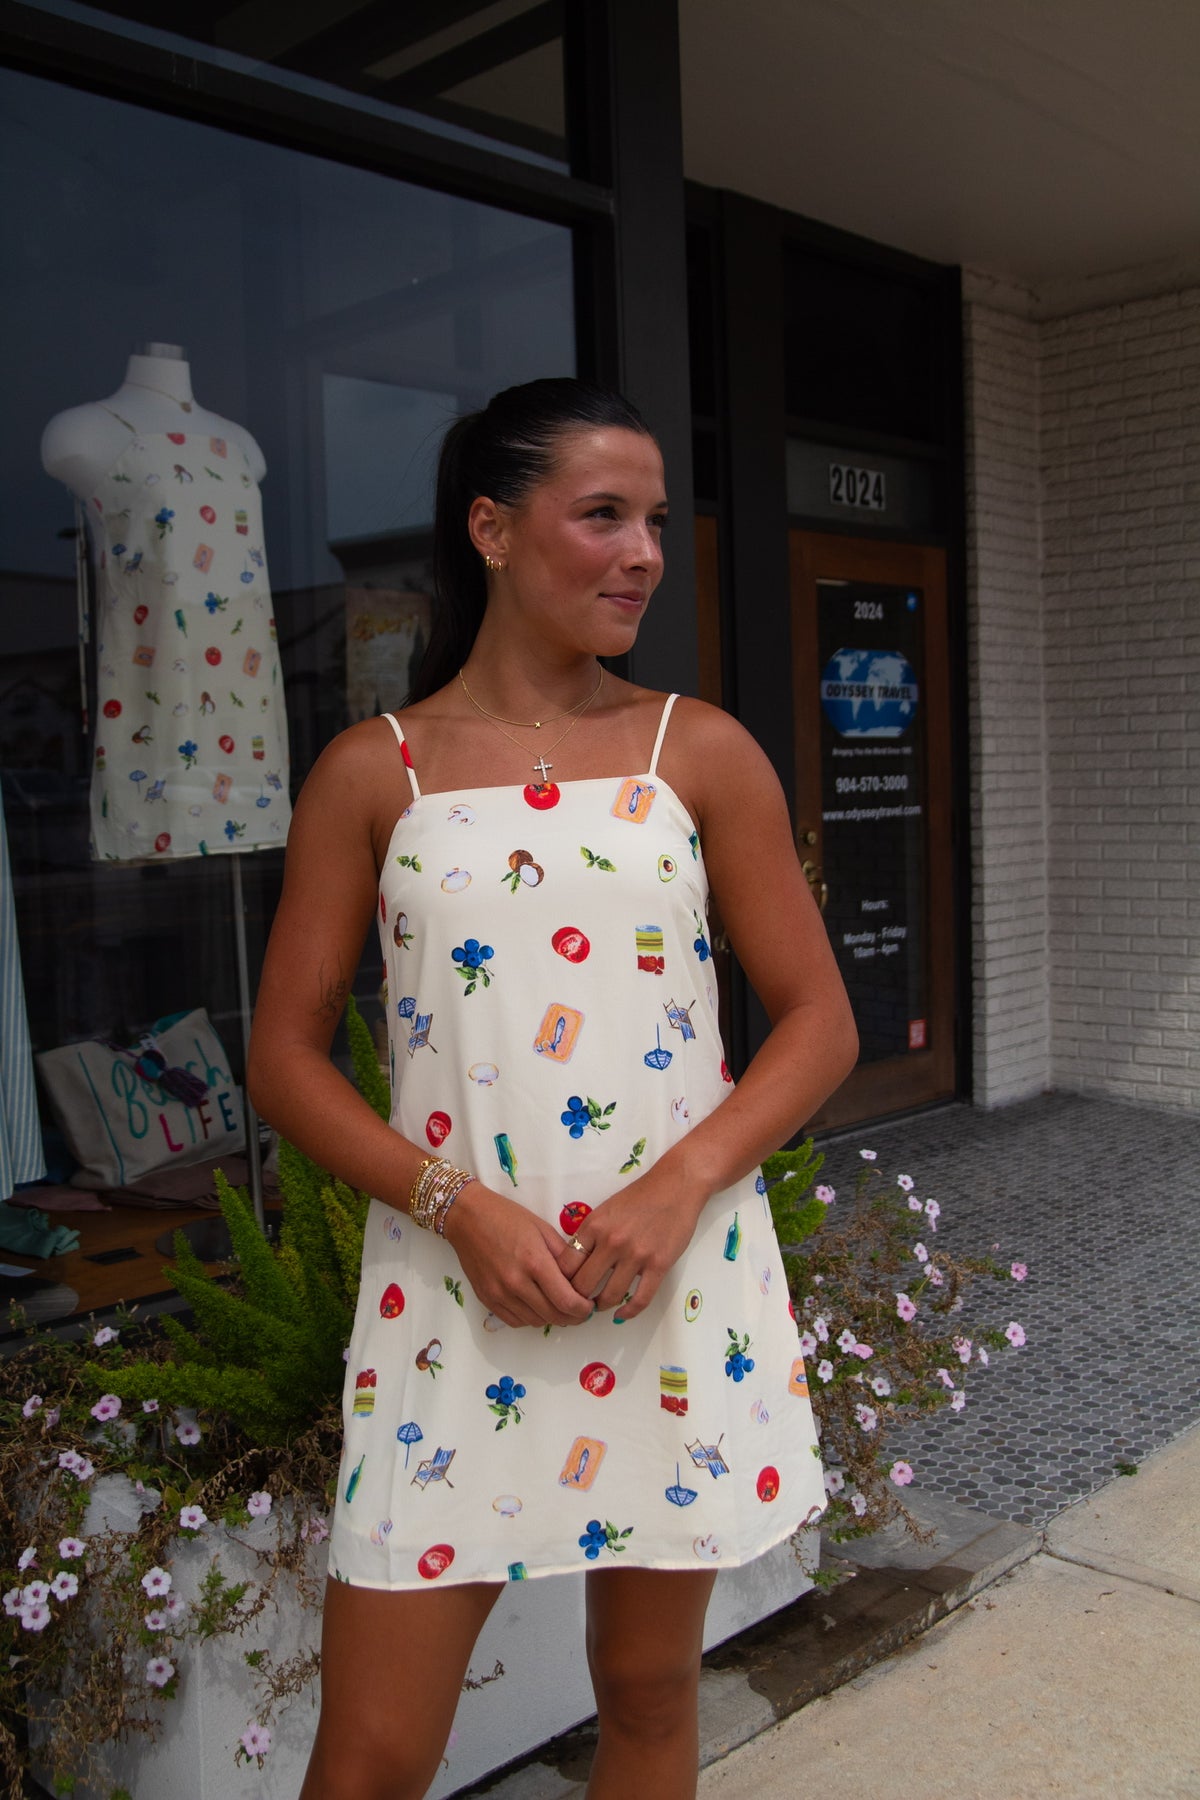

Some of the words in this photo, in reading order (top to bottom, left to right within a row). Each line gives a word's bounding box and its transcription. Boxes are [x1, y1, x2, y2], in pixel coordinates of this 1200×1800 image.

[832, 466, 883, 508] 2024
[854, 600, 884, 620] 2024
[826, 683, 874, 698] ODYSSEY
[877, 685, 912, 700] TRAVEL
[822, 804, 922, 822] www.odysseytravel.com
[861, 899, 889, 912] Hours:
[843, 931, 876, 945] Monday
[881, 925, 908, 940] Friday
[112, 1038, 231, 1139] Beh
[159, 1091, 237, 1152] LIFE
